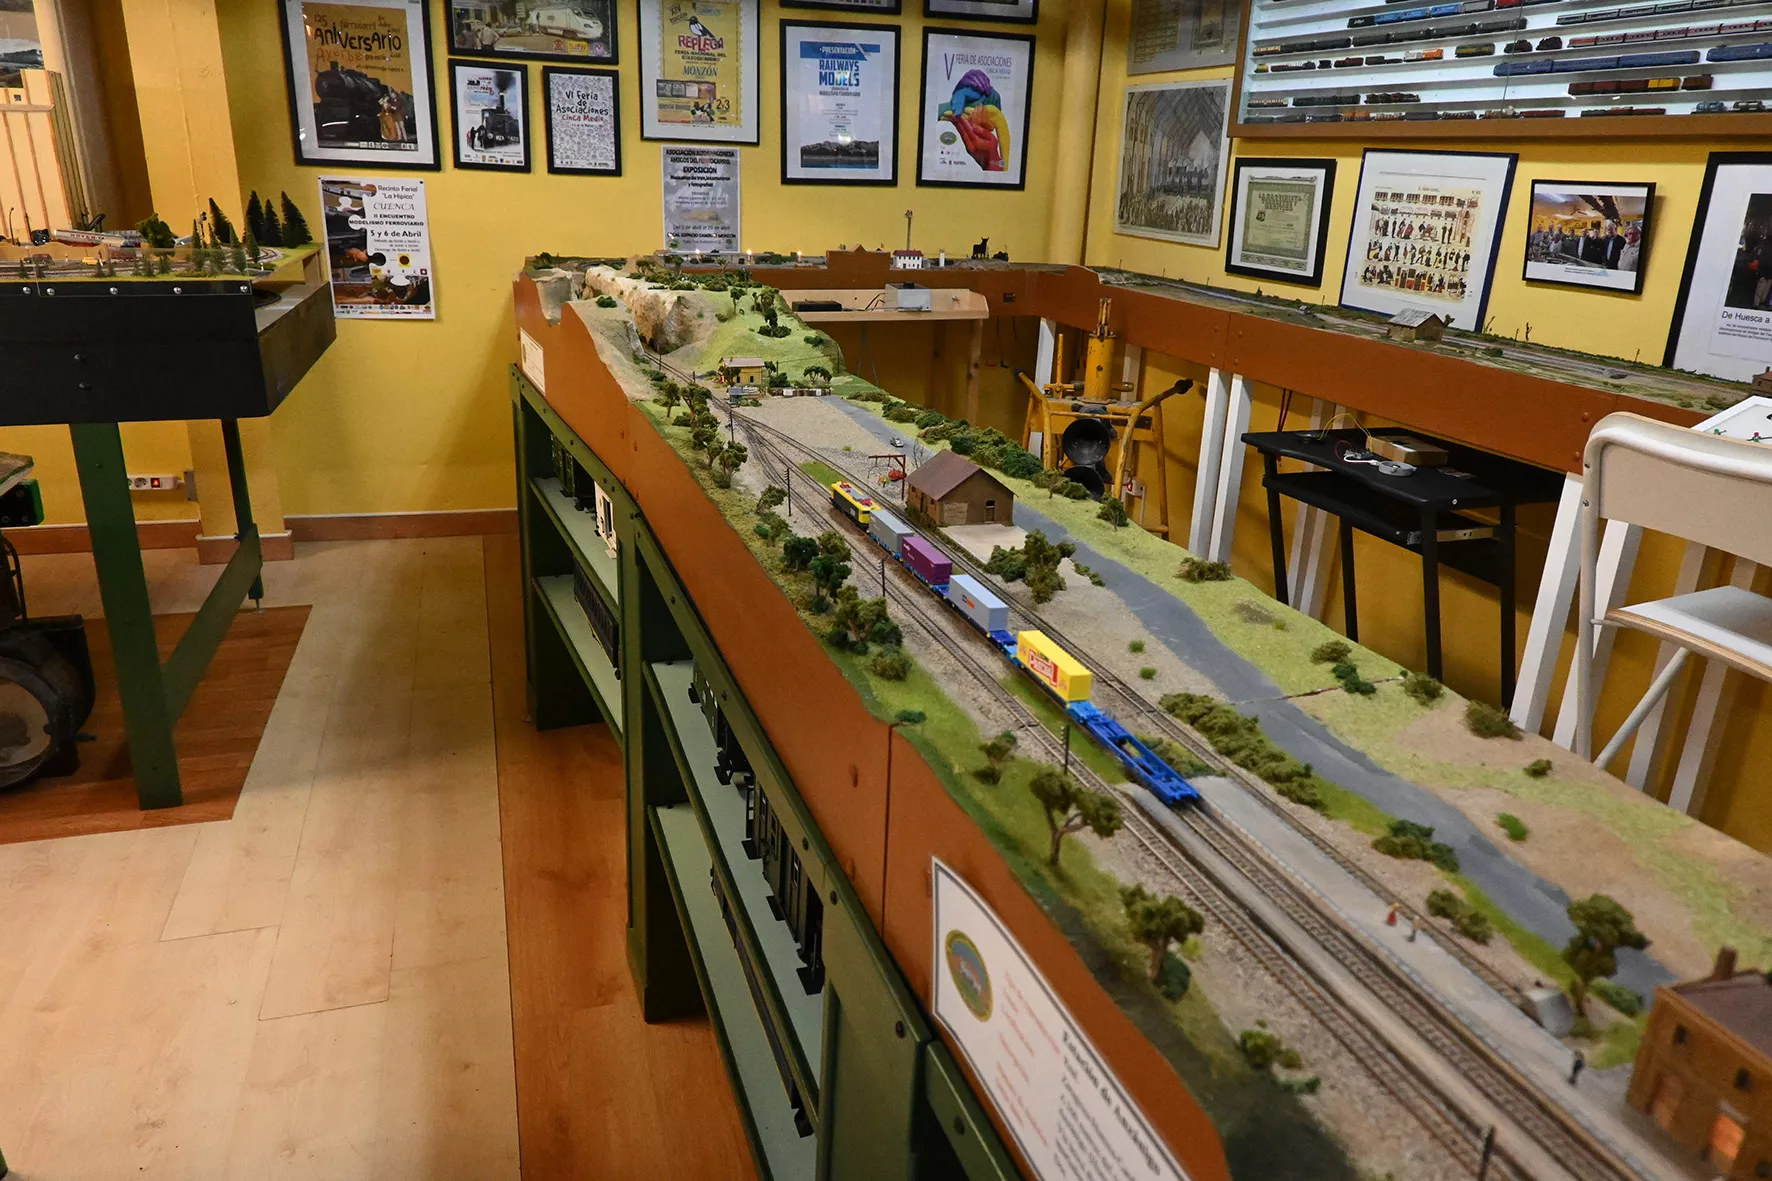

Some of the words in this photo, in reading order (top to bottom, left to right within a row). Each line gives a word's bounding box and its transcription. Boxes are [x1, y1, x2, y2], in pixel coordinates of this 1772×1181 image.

[678, 34, 724, 52] REPLEGA
[819, 59, 860, 72] RAILWAYS
[819, 71, 860, 87] MODELS
[565, 90, 574, 99] VI
[576, 90, 599, 101] Feria
[576, 99, 587, 107] de
[556, 104, 609, 116] Asociaciones
[683, 166, 717, 174] EXPOSICIÓN
[373, 202, 415, 211] CUENCA
[402, 230, 422, 238] Abril
[1721, 310, 1733, 320] De
[1735, 312, 1763, 323] Huesca
